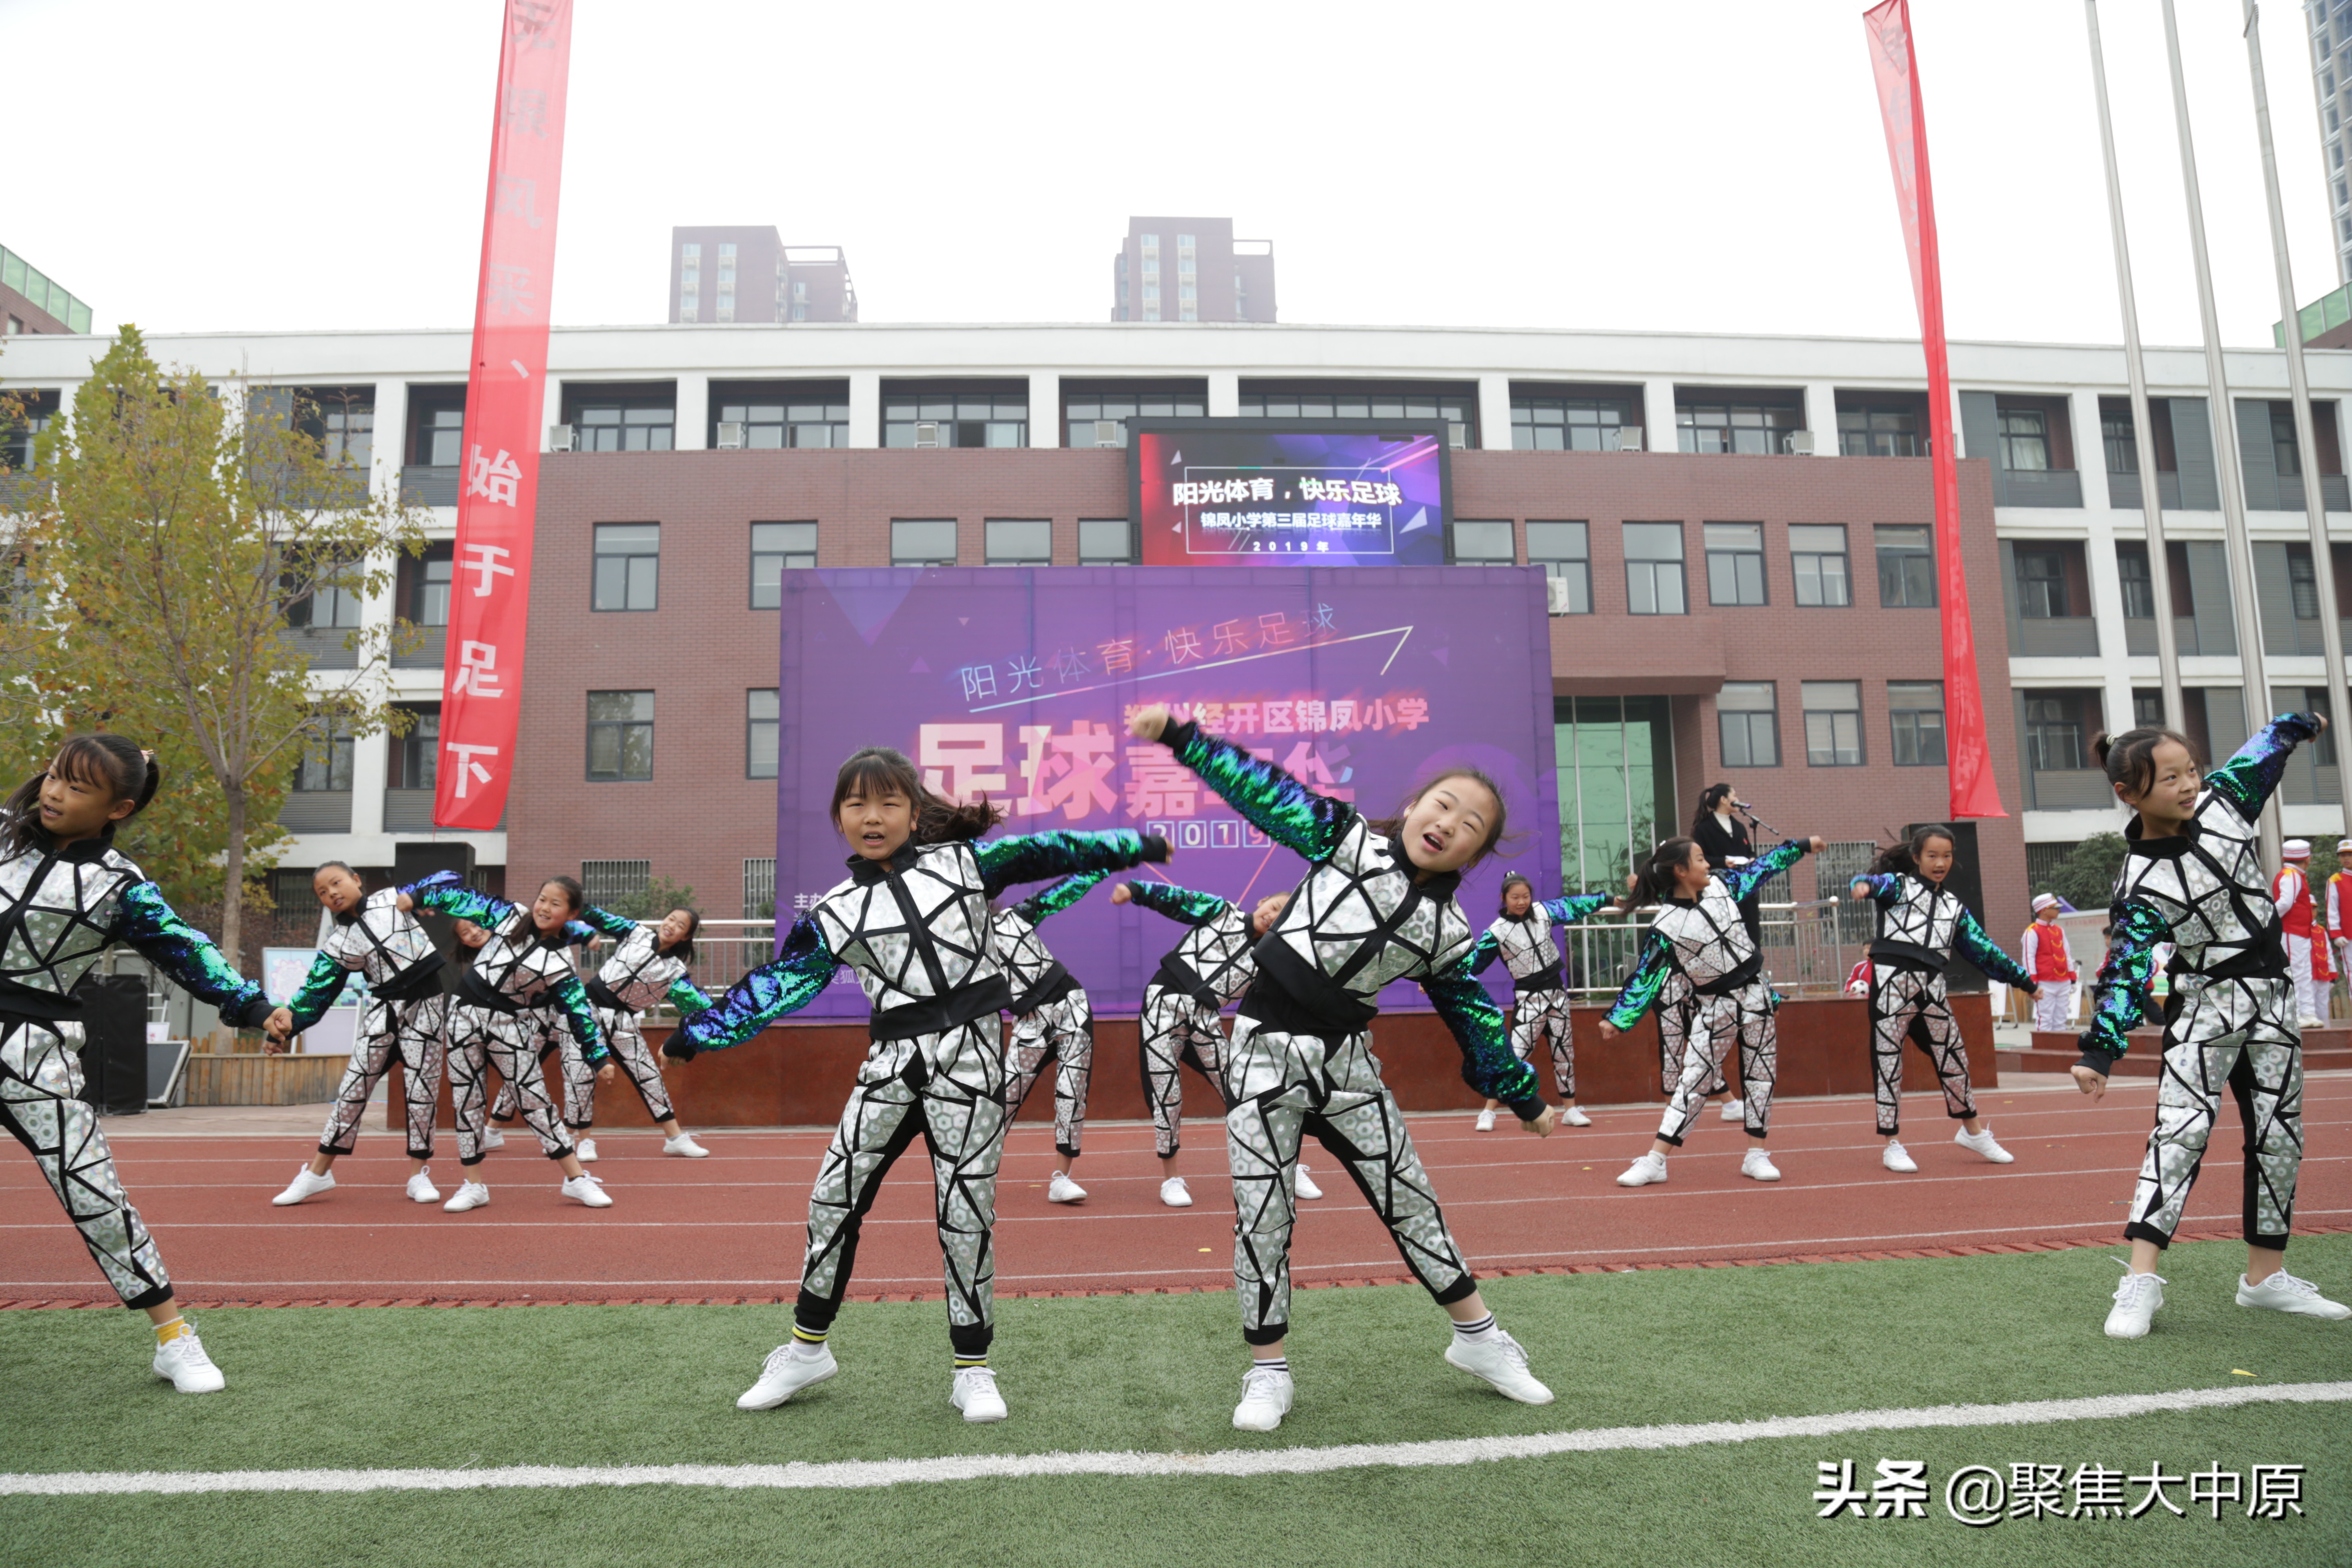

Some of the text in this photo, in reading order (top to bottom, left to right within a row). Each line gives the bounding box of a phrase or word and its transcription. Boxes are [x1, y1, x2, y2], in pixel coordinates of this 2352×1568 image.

[1200, 512, 1382, 528] 锦凤小学第三届足球嘉年华
[920, 720, 1355, 819] 足球嘉华
